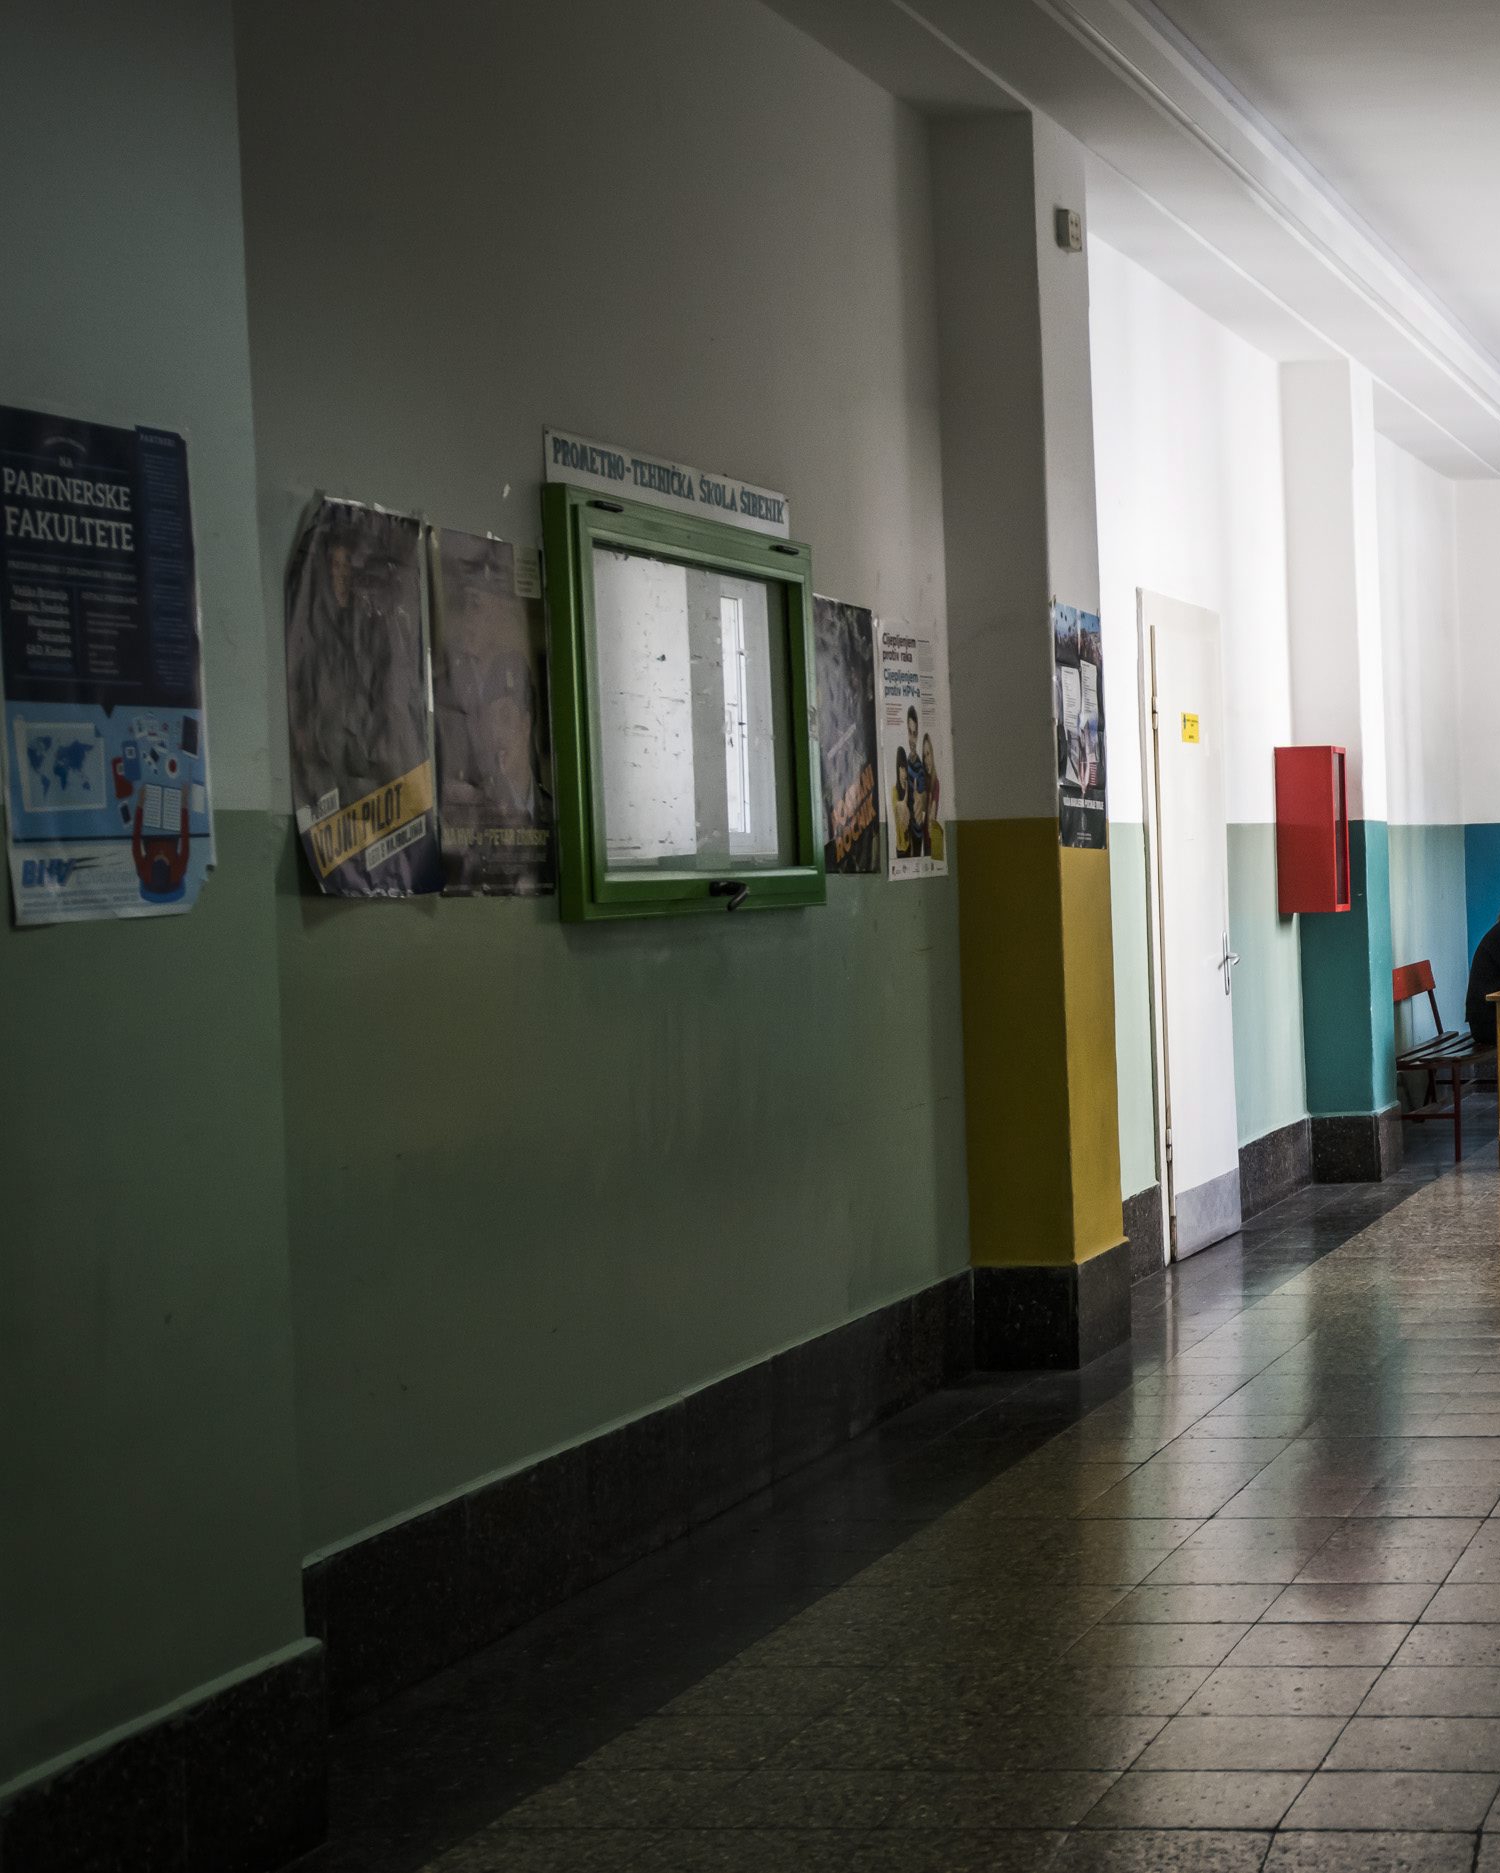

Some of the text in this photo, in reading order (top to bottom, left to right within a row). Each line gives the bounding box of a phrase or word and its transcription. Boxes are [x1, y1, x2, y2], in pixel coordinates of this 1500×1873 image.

[2, 466, 131, 512] PARTNERSKE
[552, 436, 784, 525] PROMETNO-TEHNIČKA ŠKOLA ŠIBENIK
[4, 505, 135, 551] FAKULTETE
[883, 632, 916, 650] Cijepljenjem
[883, 651, 912, 663] protiv raka
[884, 668, 918, 685] Cijepljenjem
[885, 685, 921, 698] protiv HPV-a
[312, 809, 358, 869] VOJNI
[361, 783, 403, 840] PILOT
